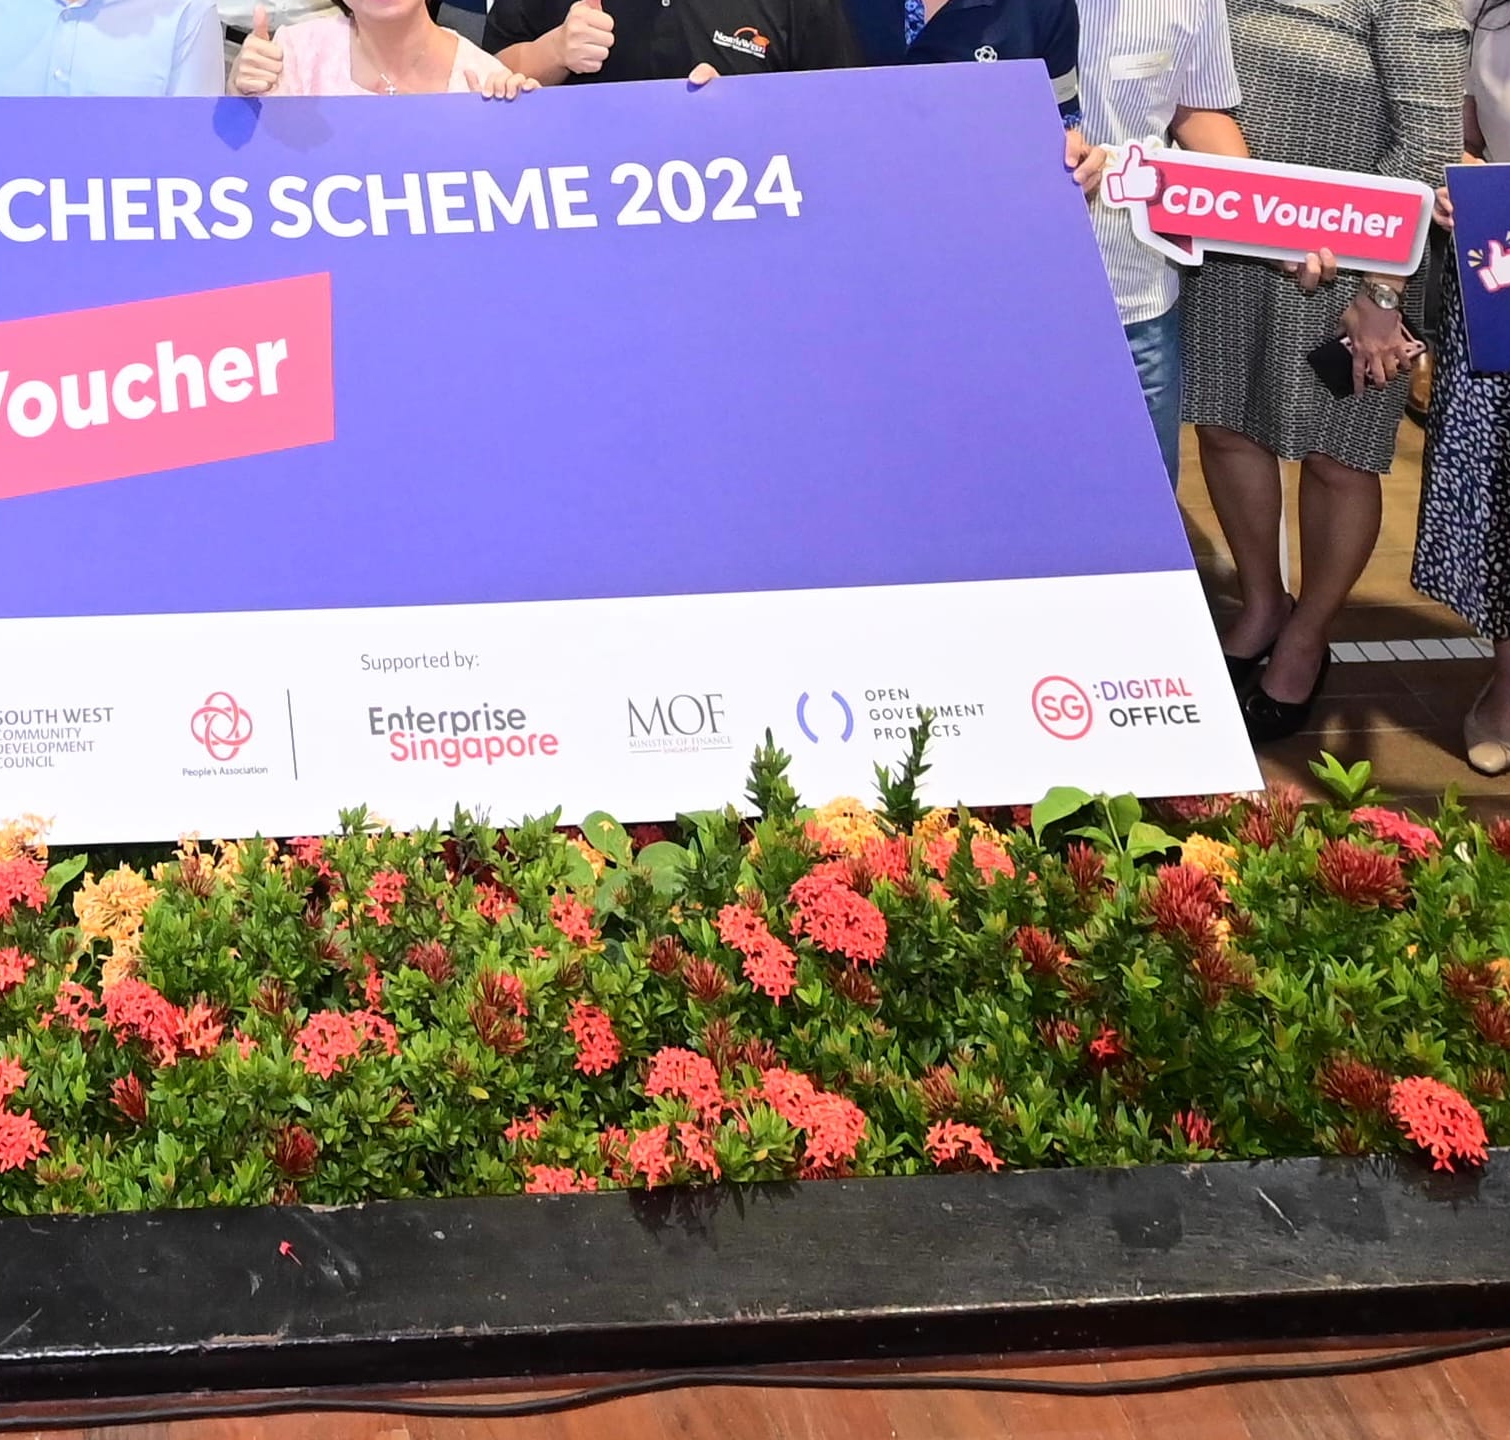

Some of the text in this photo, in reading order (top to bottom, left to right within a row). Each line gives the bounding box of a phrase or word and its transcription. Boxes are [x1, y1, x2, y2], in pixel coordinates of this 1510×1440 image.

[269, 169, 598, 240] SCHEME
[611, 154, 805, 228] 2024
[1162, 185, 1404, 239] CDC Voucher
[361, 650, 480, 673] Supported by:
[865, 687, 910, 702] OPEN
[63, 707, 114, 723] WEST
[368, 702, 527, 737] Enterprise
[628, 694, 725, 737] MOF
[1041, 695, 1085, 721] SG
[1109, 704, 1201, 728] OFFICE
[389, 730, 560, 769] Singapore
[182, 765, 268, 780] People's Association
